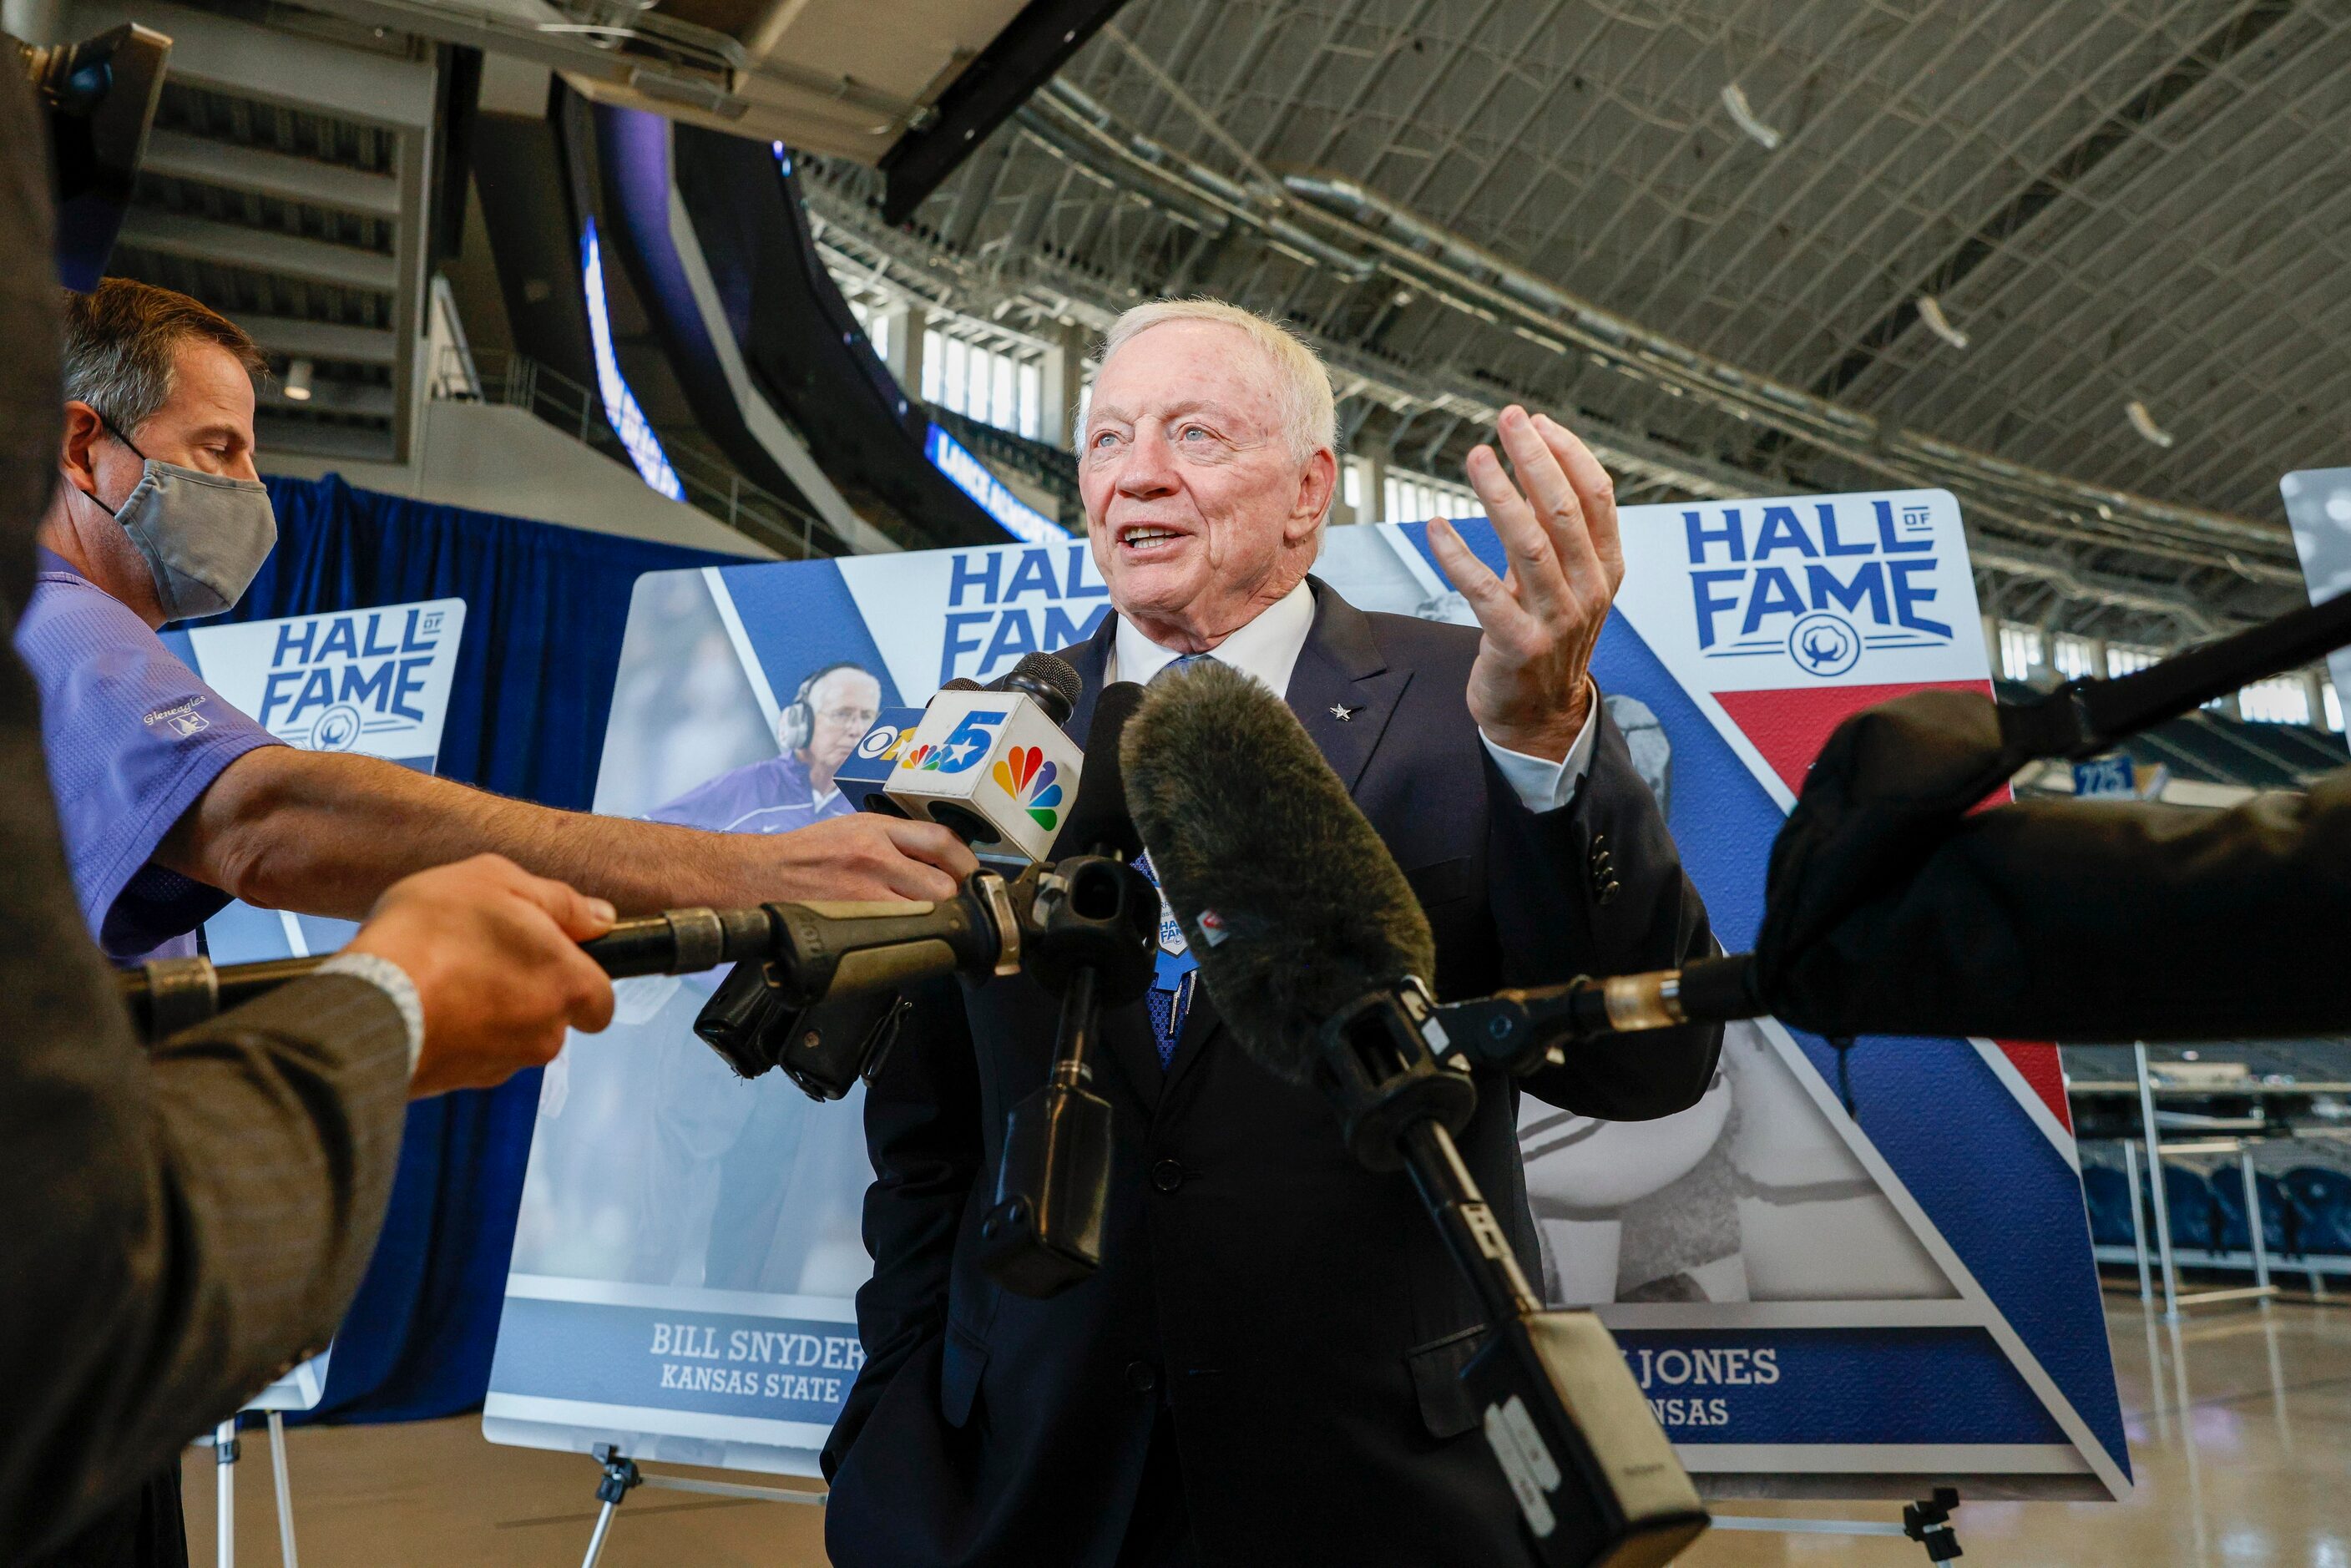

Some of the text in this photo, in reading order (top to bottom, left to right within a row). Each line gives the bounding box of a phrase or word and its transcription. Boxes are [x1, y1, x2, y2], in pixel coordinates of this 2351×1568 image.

[1681, 500, 1934, 565] HALL OF
[948, 546, 1110, 607] HAL
[1689, 558, 1954, 650] FAME
[271, 609, 442, 667] HALL OF
[939, 604, 1113, 690] FAM
[143, 695, 207, 726] Gleneagles
[259, 656, 435, 727] FAME
[937, 711, 1008, 774] 5
[1160, 920, 1178, 931] HA
[650, 1323, 867, 1372] BILL SNYDER
[1639, 1348, 1780, 1389] JONES
[660, 1363, 841, 1404] KANSAS STATE
[1646, 1399, 1729, 1426] NSAS
